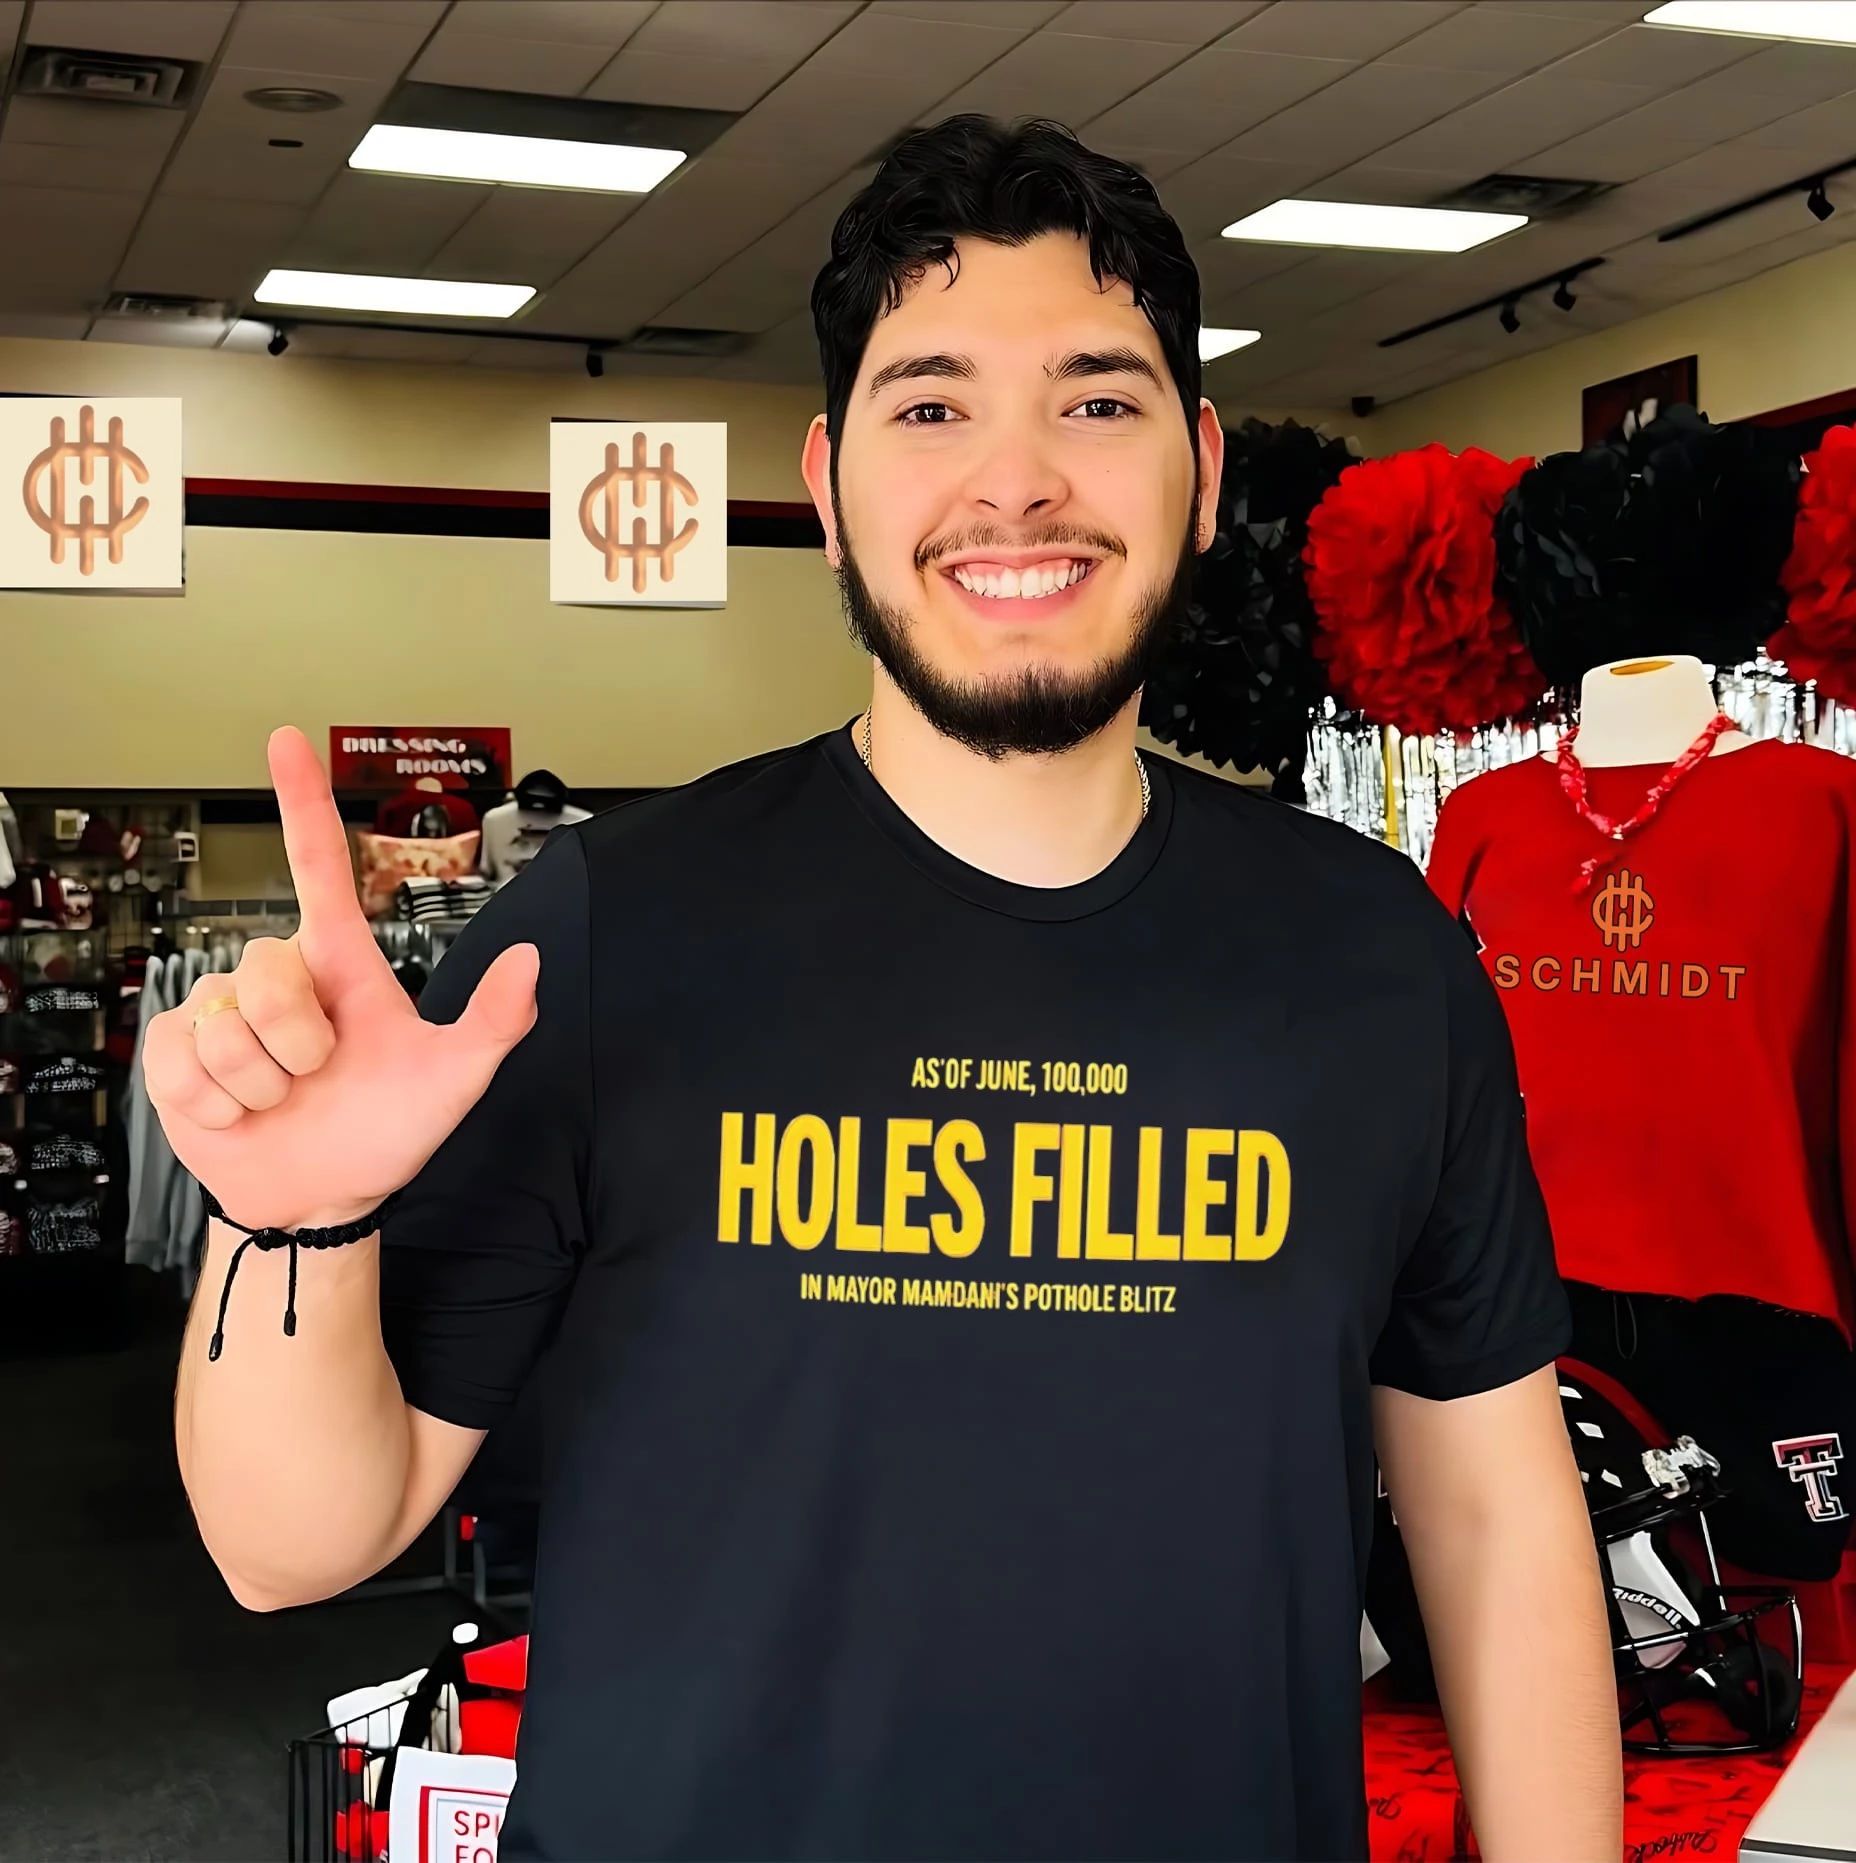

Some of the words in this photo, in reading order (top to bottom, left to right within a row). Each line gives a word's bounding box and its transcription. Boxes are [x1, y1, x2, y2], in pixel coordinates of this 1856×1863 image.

[1494, 954, 1746, 1000] SCHMIDT
[975, 1059, 1037, 1097] JUNE,
[1041, 1061, 1128, 1096] 100,000
[717, 1111, 987, 1259] HOLES
[1009, 1121, 1292, 1262] FILLED
[800, 1272, 823, 1301] IN
[826, 1274, 897, 1306] MAYOR
[901, 1278, 1020, 1311] MAMDANI'S
[1023, 1282, 1117, 1313] POTHOLE
[1119, 1284, 1177, 1313] BLITZ
